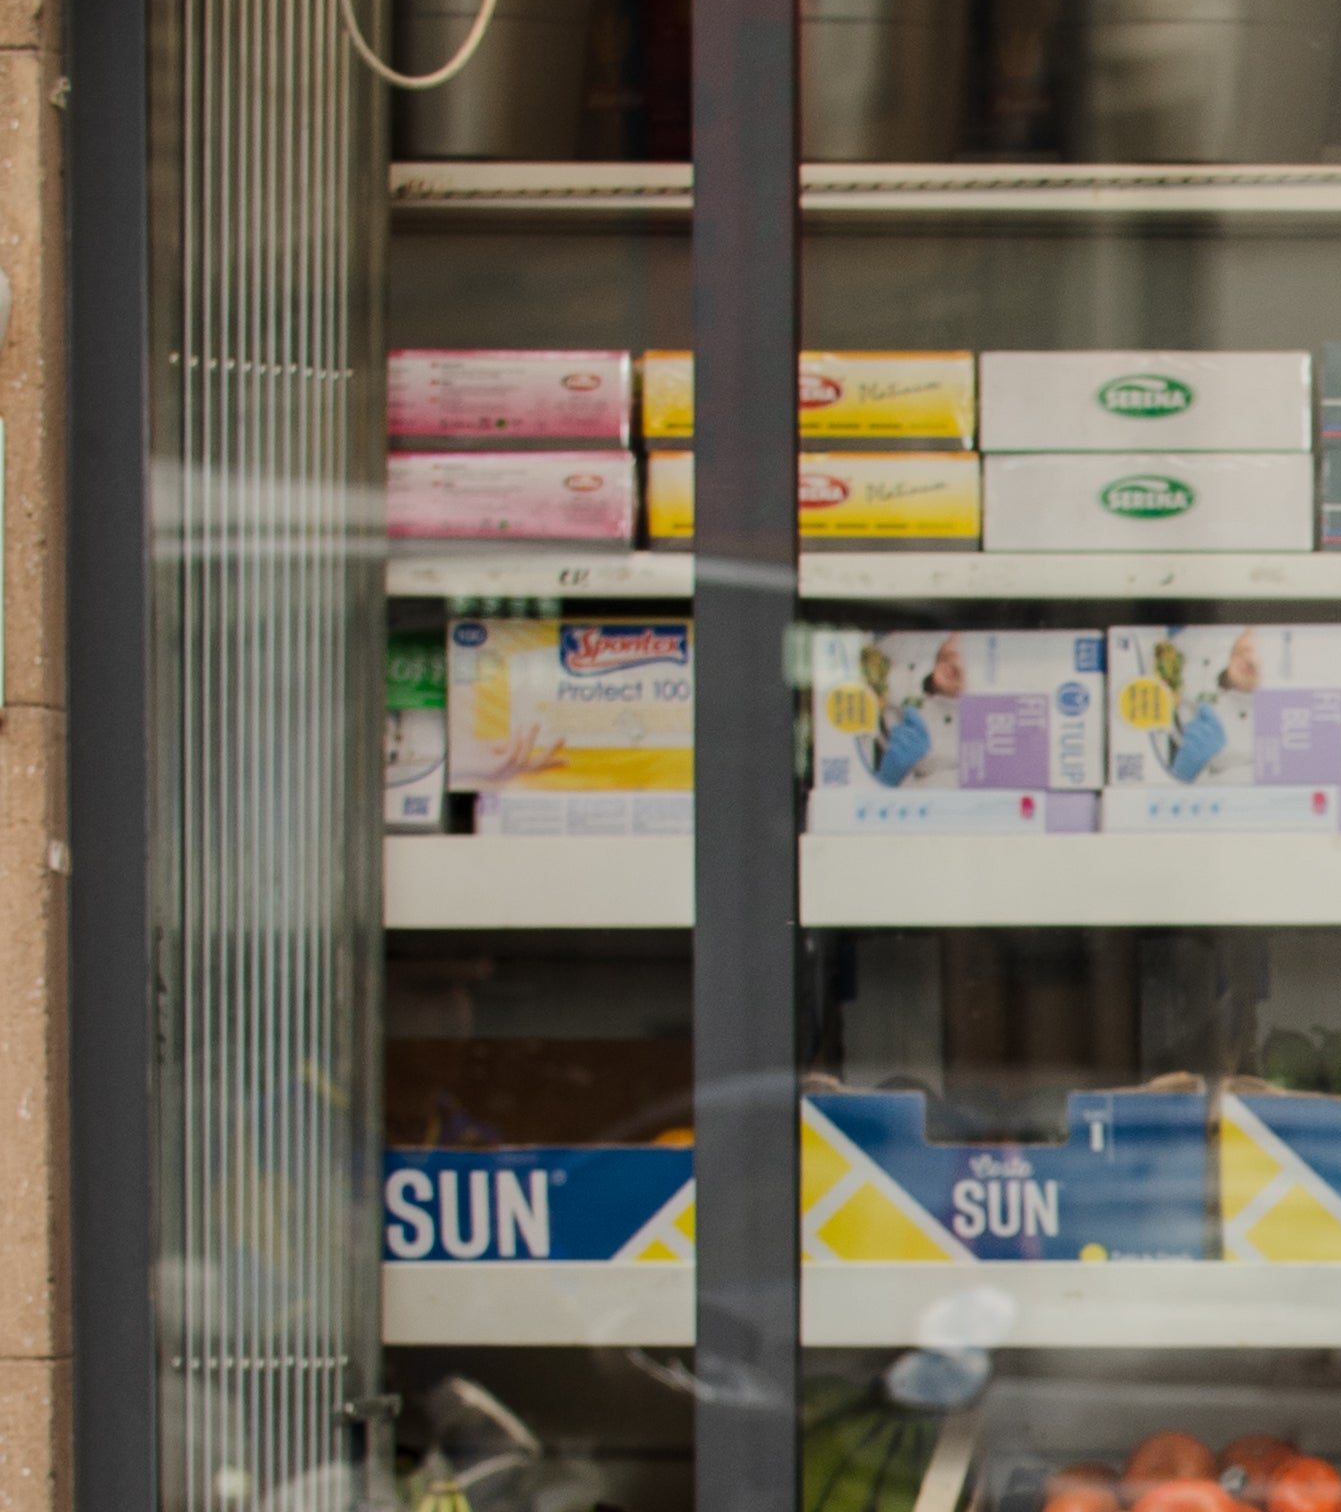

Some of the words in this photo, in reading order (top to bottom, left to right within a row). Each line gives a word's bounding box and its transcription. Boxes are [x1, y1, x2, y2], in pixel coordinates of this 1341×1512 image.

[1105, 385, 1187, 412] SERENA
[1107, 485, 1190, 513] SERENA
[571, 626, 682, 667] Spontex
[556, 680, 644, 704] Protect
[652, 680, 692, 704] 100
[984, 710, 1017, 757] BLU
[1281, 706, 1311, 751] BLU
[1059, 720, 1086, 785] TULIP
[386, 1168, 551, 1261] SUN
[951, 1178, 1060, 1239] SUN
